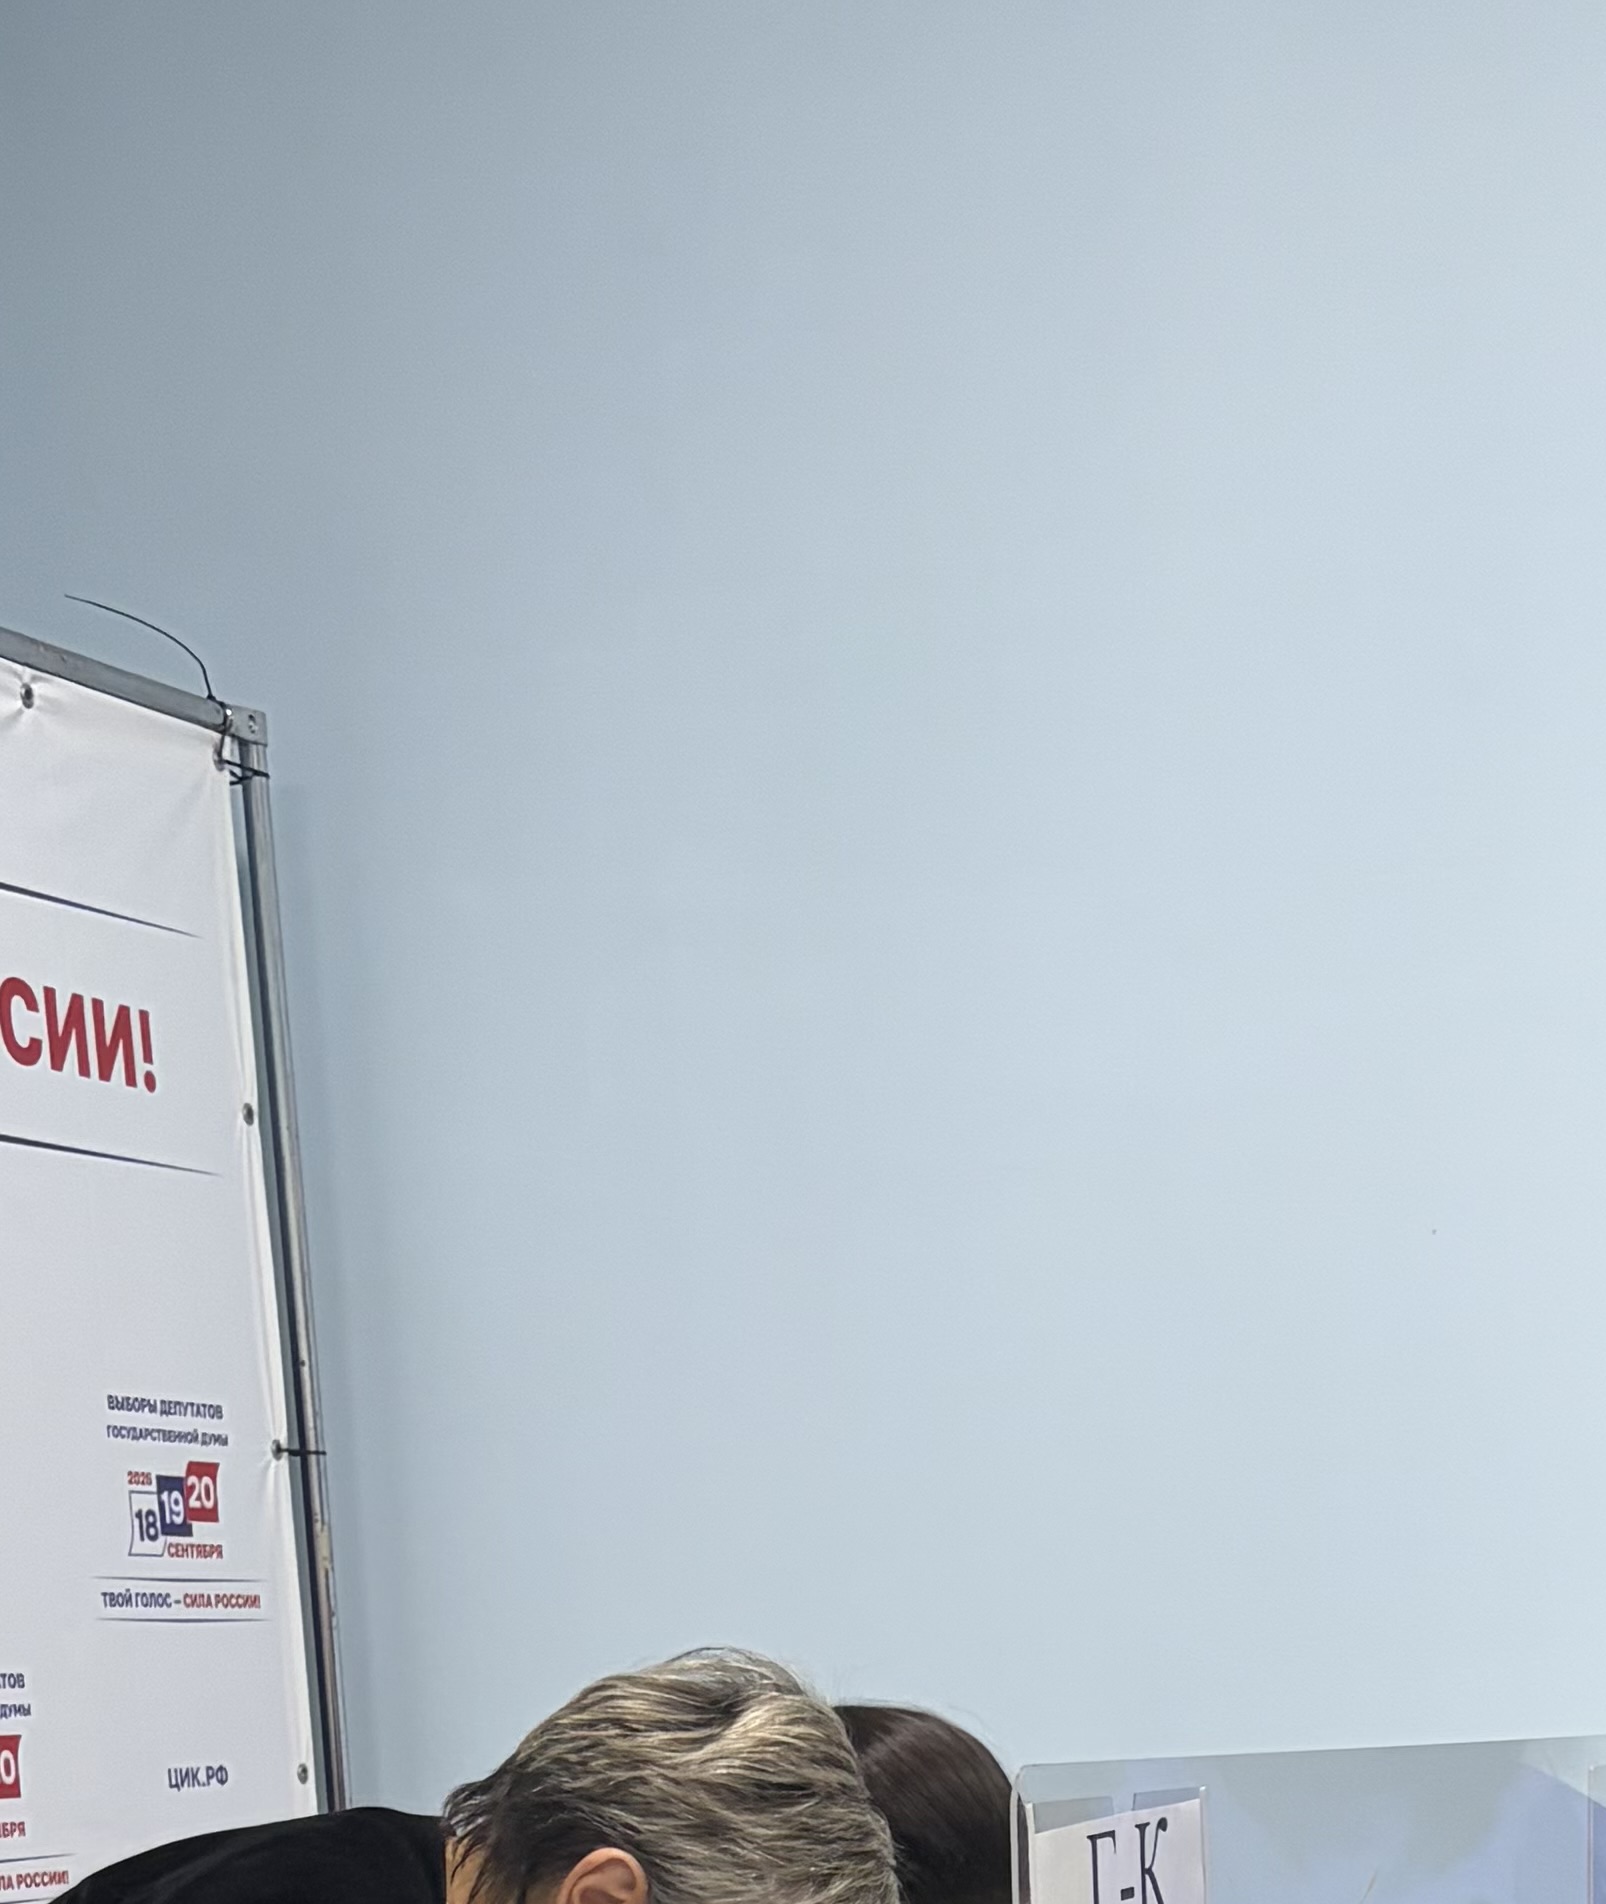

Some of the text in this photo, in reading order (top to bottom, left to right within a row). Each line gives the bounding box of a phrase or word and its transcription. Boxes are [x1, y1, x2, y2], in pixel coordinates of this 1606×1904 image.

[107, 1394, 224, 1420] ВЫБОРЫ ДЕПУТАТОВ
[106, 1424, 229, 1447] ГОСУДАРСТВЕННОЙ ДУМЫ
[127, 1470, 153, 1486] 2026
[135, 1475, 215, 1542] 18 19 20
[167, 1542, 224, 1559] СЕНТЯБРЯ
[101, 1588, 134, 1609] ТВОЙ
[134, 1592, 173, 1609] ГОЛОС
[183, 1593, 213, 1609] СИЛА
[214, 1593, 262, 1610] РОССИИ!
[0, 1672, 26, 1689] ТОВ
[168, 1764, 229, 1792] ЦИК.РФ
[0, 1821, 26, 1838] БРЯ
[16, 1870, 70, 1890] РОССИИ!
